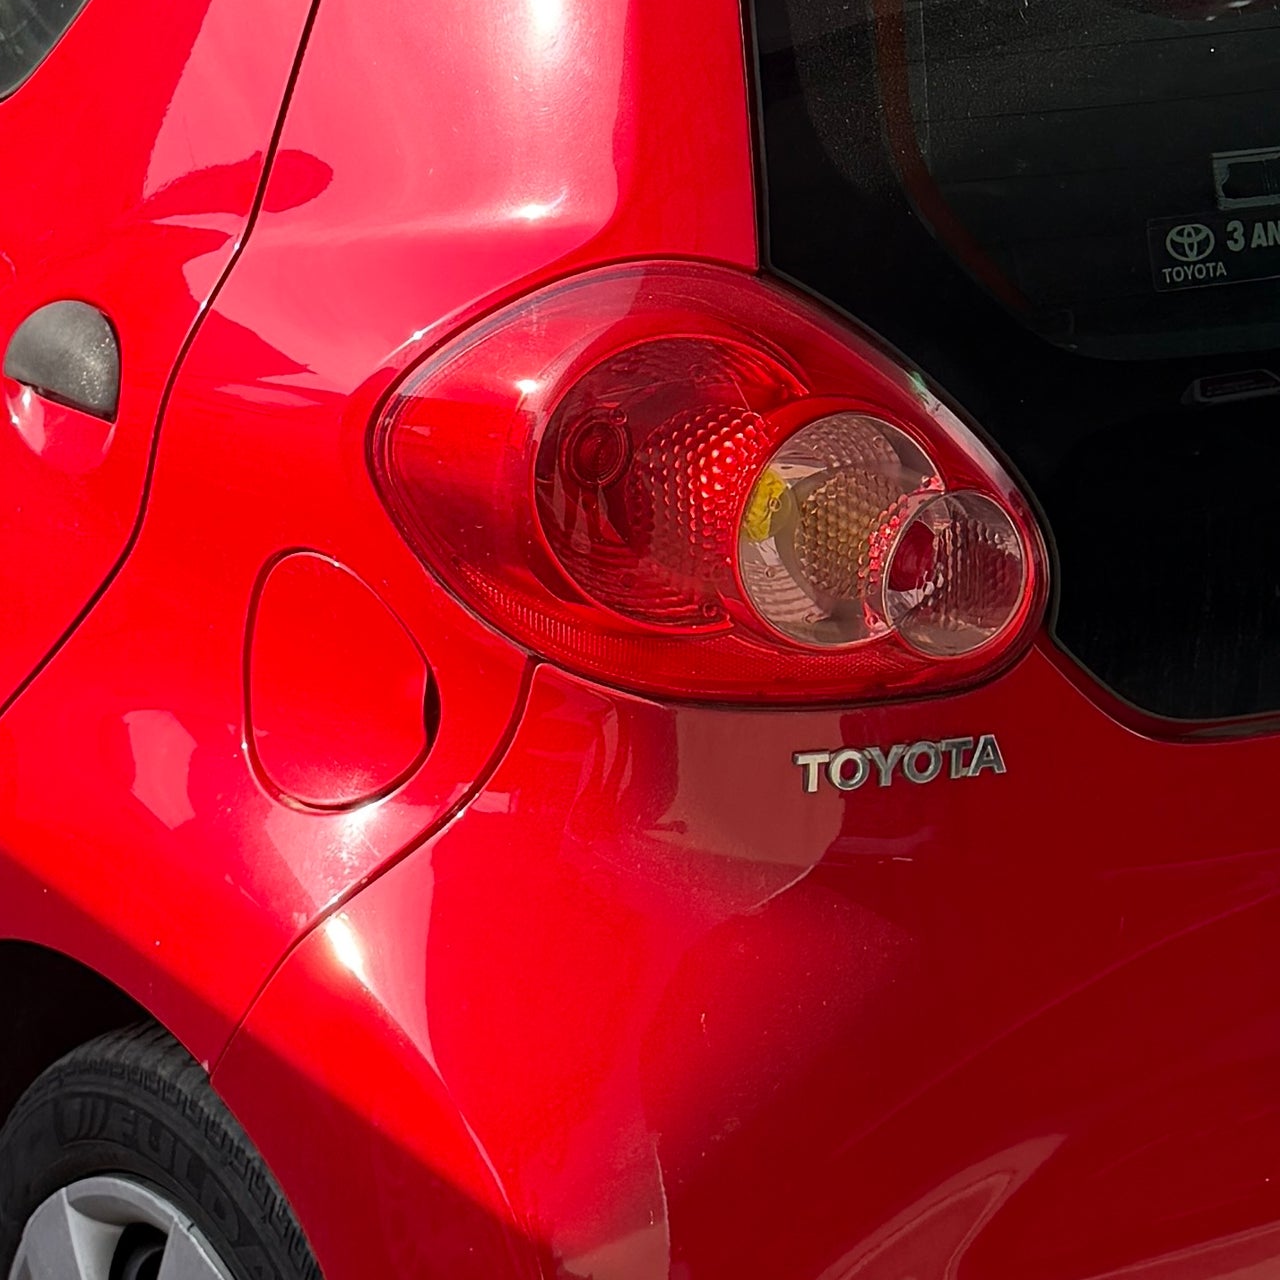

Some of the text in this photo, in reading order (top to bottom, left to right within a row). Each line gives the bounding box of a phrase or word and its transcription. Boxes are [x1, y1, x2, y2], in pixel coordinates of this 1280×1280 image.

[1226, 220, 1245, 252] 3
[1162, 261, 1227, 284] TOYOTA
[792, 733, 1007, 793] TOYOTA
